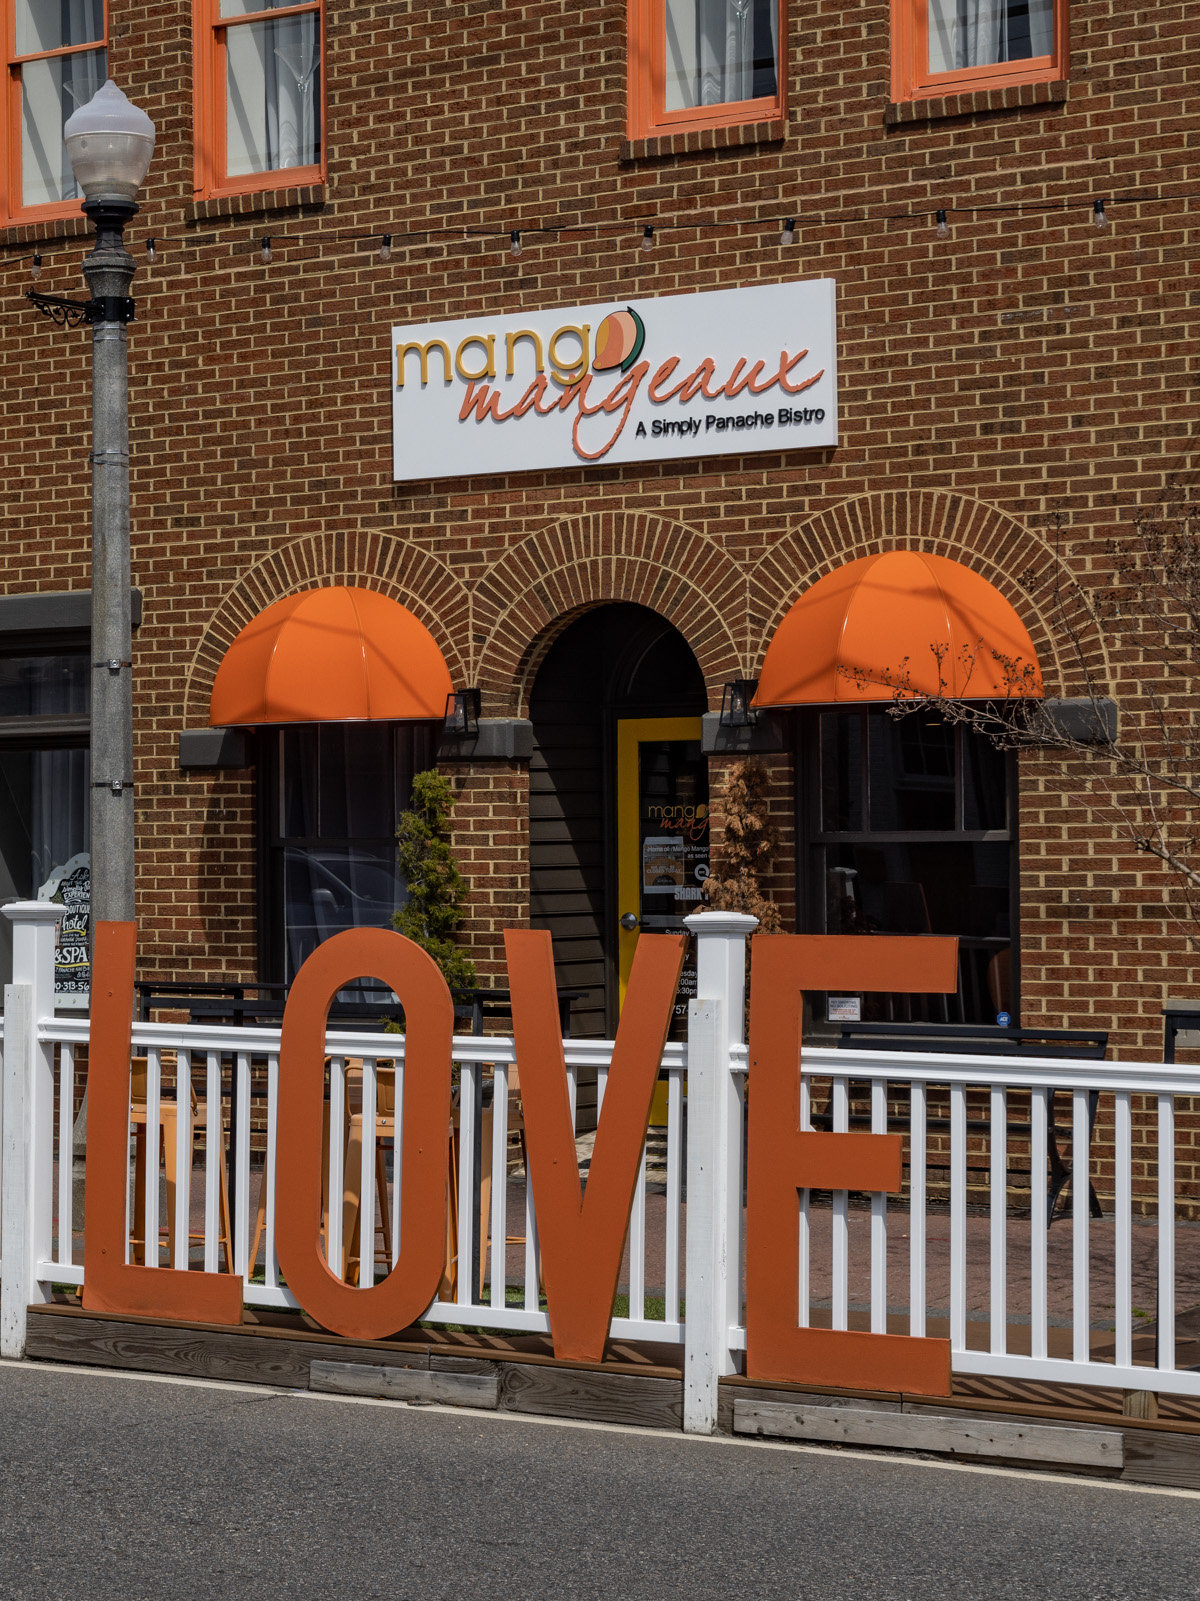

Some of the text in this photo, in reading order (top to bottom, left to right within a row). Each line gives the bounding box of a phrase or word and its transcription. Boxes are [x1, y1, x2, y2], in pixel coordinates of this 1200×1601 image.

[458, 348, 825, 460] mangeaux
[636, 407, 826, 437] A Simply Panache Bistro
[660, 816, 709, 841] mang
[63, 891, 90, 900] EXPERIEN
[674, 887, 703, 901] SHARK
[64, 904, 90, 915] BOUTIQU
[62, 914, 88, 931] hotel
[82, 920, 959, 1398] LOVE
